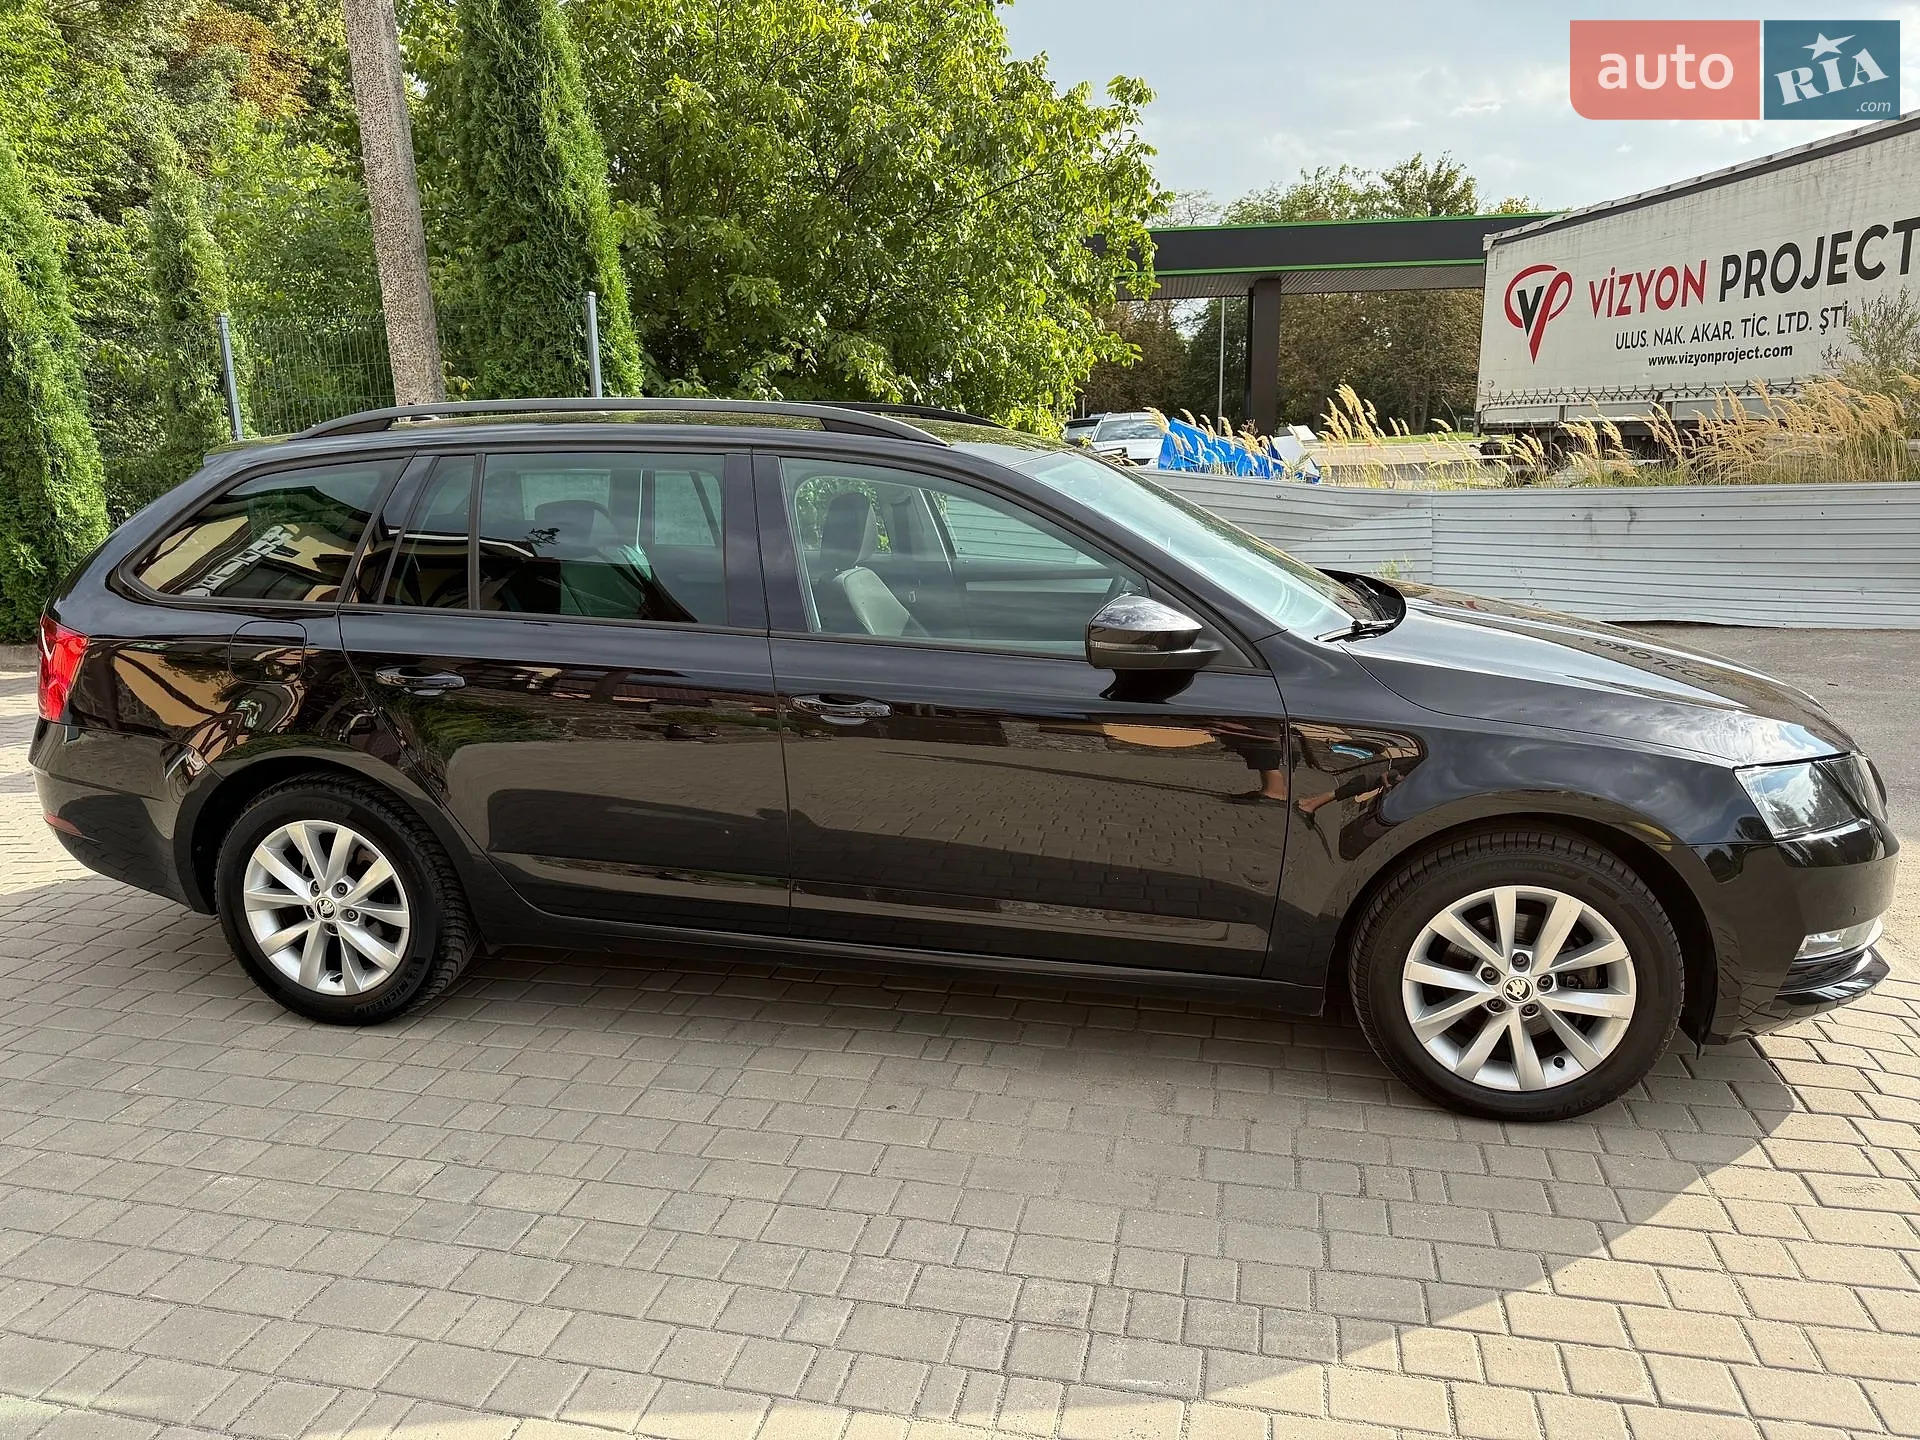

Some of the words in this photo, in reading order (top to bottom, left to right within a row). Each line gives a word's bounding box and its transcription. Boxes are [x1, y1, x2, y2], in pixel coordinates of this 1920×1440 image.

[1719, 216, 1920, 302] PROJECT
[1615, 330, 1649, 350] ULUS.
[1653, 326, 1686, 347] NAK.
[1690, 320, 1735, 343] AKAR.
[1777, 311, 1812, 334] LTD.
[1648, 344, 1793, 367] www.vizyonproject.com
